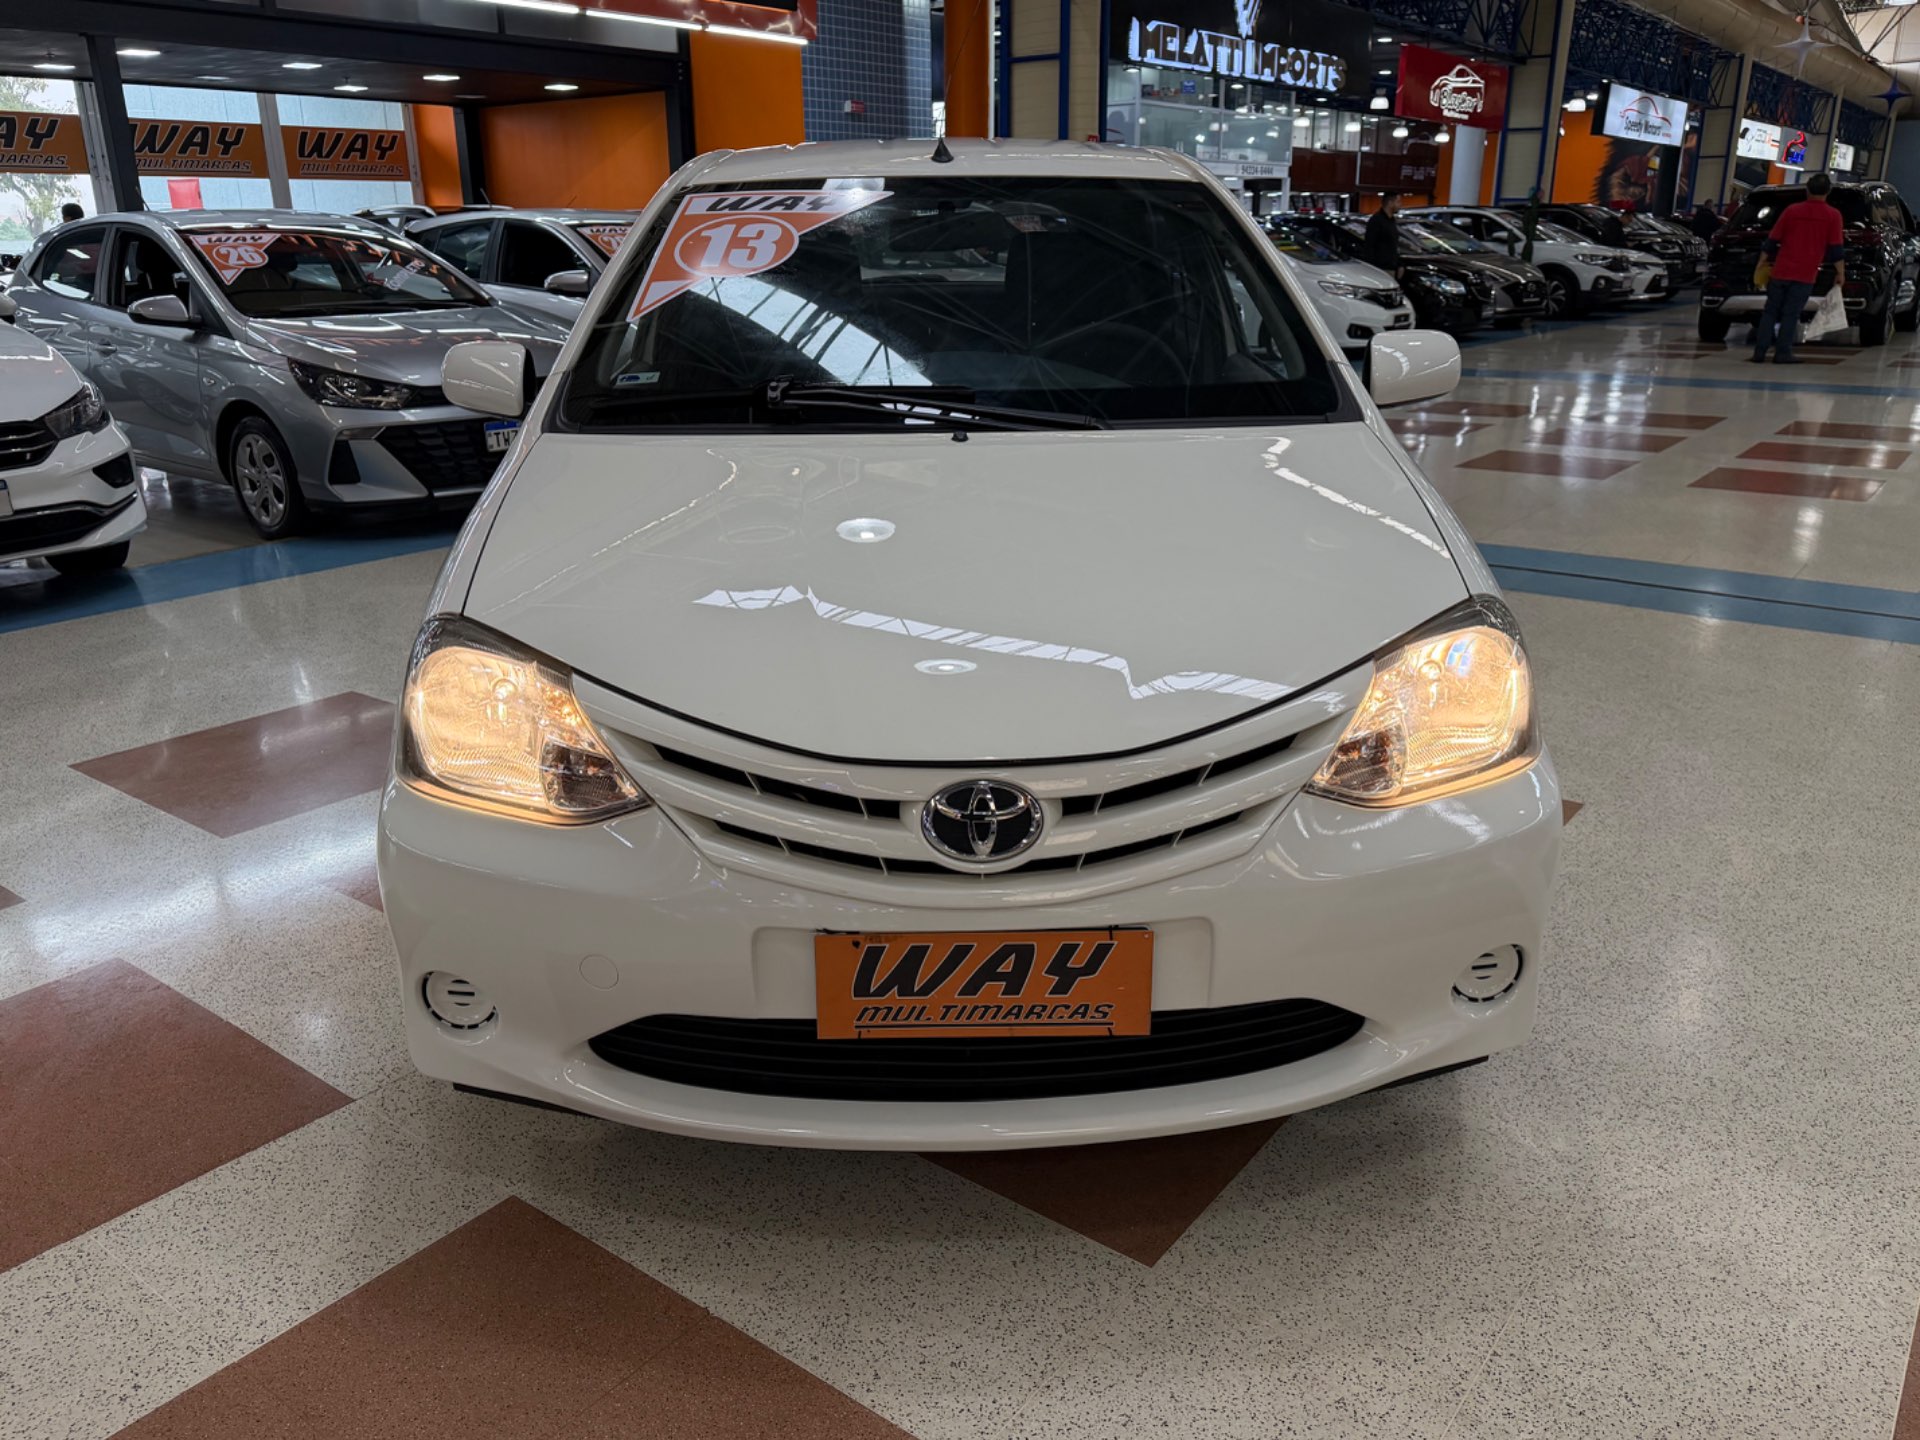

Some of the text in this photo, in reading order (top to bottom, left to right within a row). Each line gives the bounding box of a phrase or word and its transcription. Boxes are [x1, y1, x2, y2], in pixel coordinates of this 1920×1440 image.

[128, 121, 247, 158] WAY
[297, 129, 400, 161] WAY
[135, 157, 251, 171] MULTIMARCAS
[301, 162, 404, 174] MULTIMARCAS
[705, 195, 837, 212] WAY
[207, 235, 263, 244] WAY
[700, 222, 783, 269] 13
[218, 246, 263, 265] 26
[852, 940, 1118, 1000] WAY
[854, 1002, 1115, 1023] MULTIMARCAS
